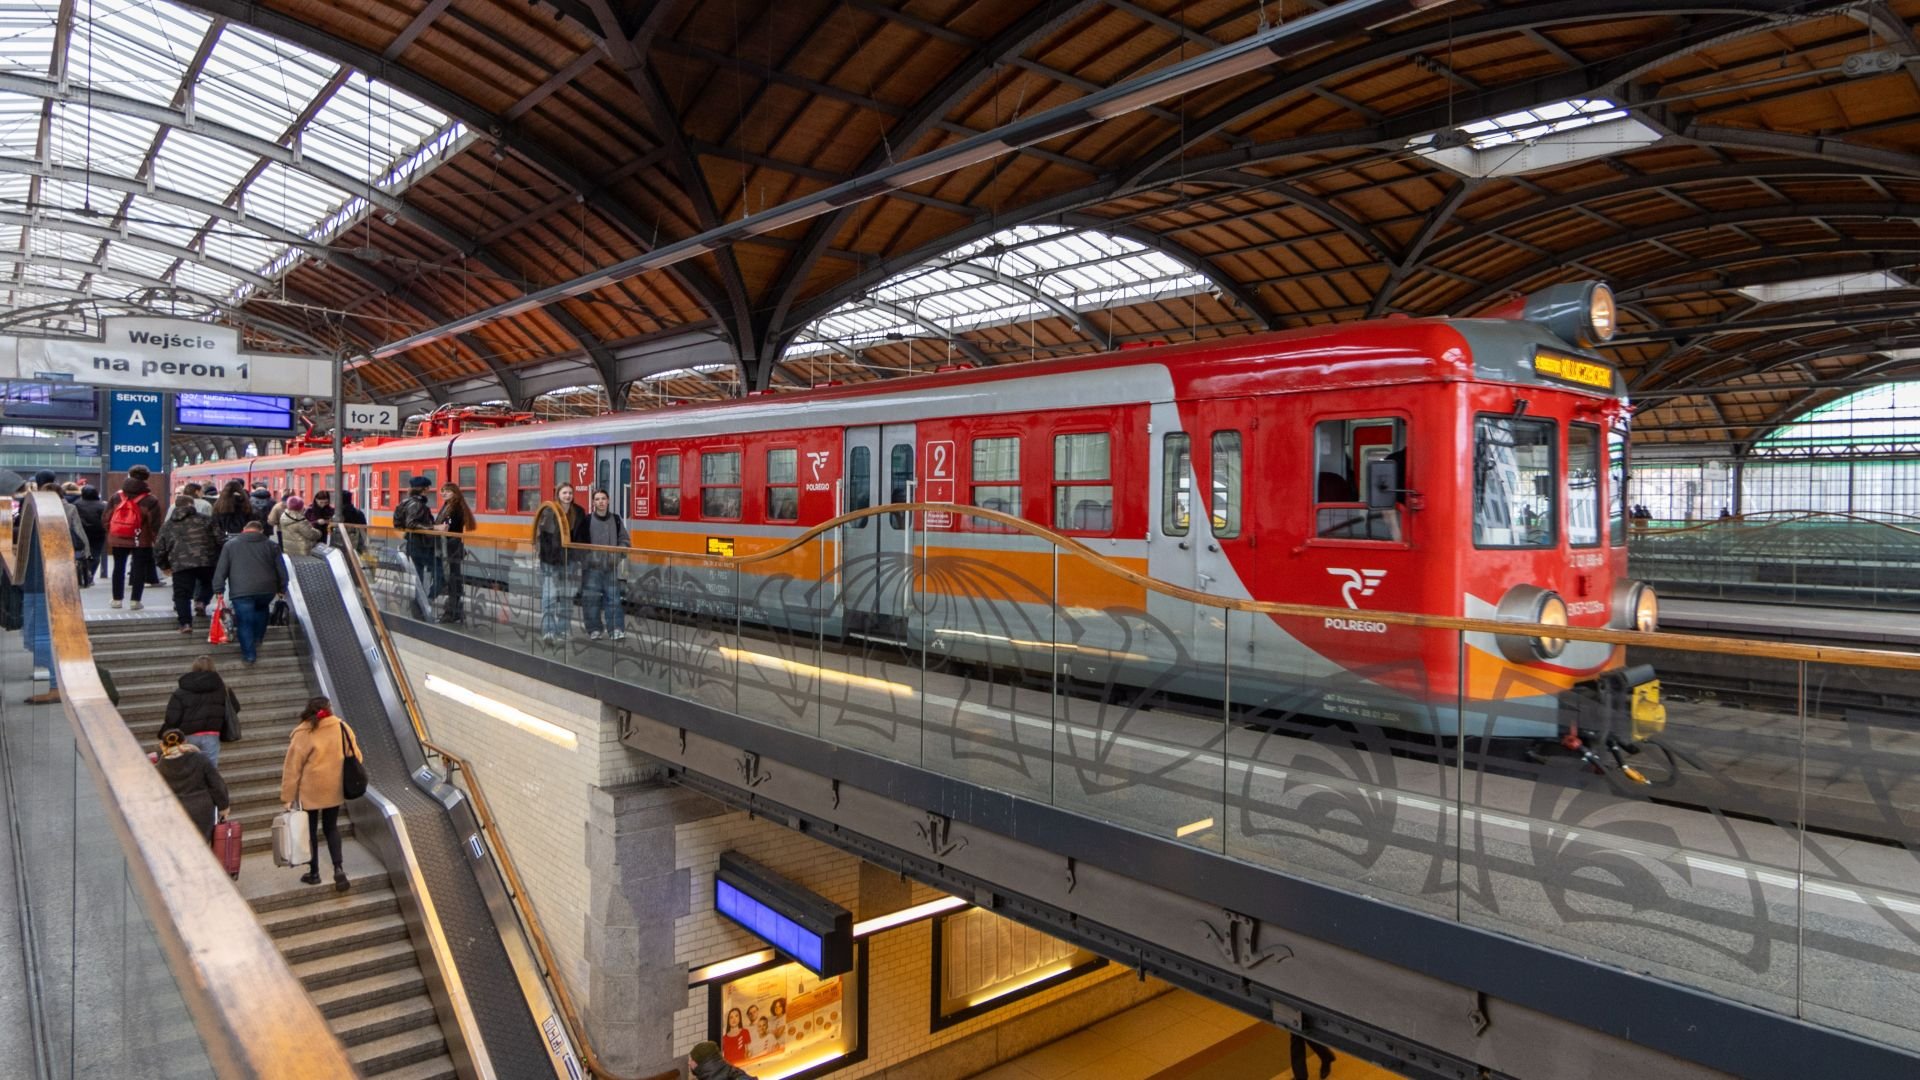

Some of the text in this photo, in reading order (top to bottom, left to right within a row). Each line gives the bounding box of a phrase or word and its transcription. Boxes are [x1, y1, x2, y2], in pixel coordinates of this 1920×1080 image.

[129, 330, 216, 349] Wejście
[93, 356, 249, 379] na peron 1
[116, 393, 158, 403] SEKTOR
[127, 409, 147, 427] A
[352, 410, 390, 425] tor 2
[114, 441, 160, 454] PERON 1
[639, 458, 646, 480] 2
[933, 445, 946, 476] 2
[805, 483, 830, 491] POLREGIO
[1324, 617, 1387, 634] POLREGIO
